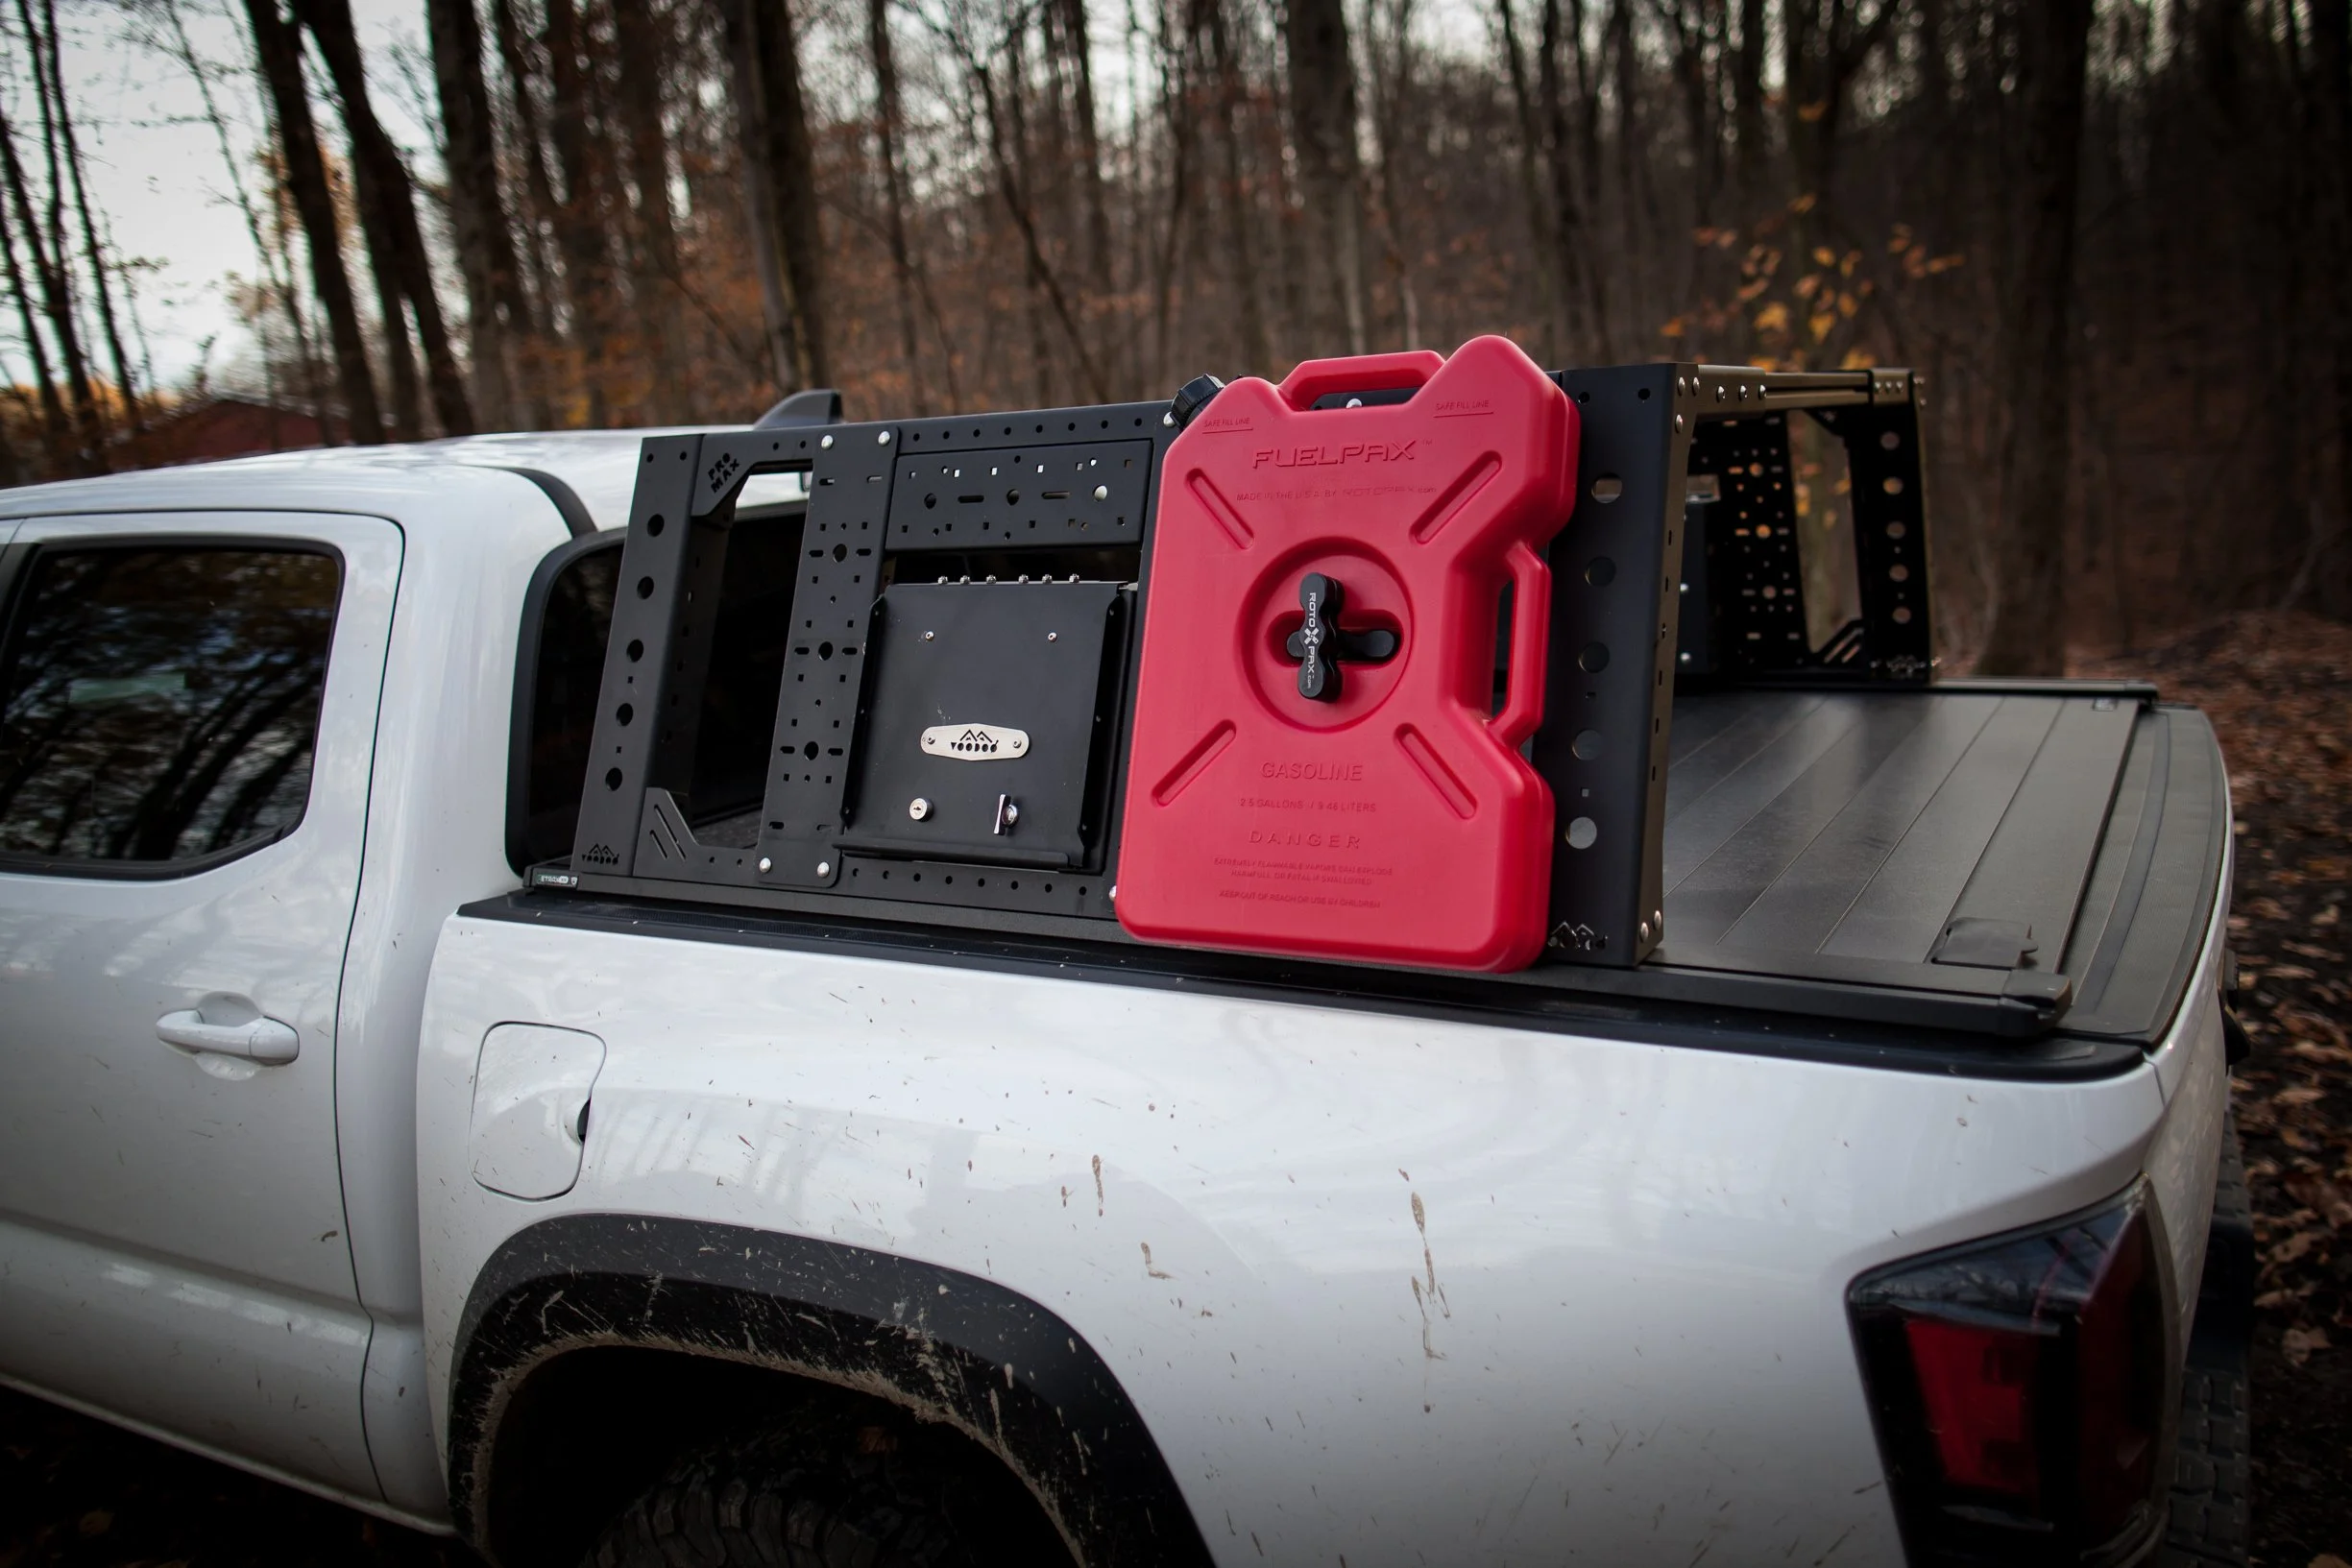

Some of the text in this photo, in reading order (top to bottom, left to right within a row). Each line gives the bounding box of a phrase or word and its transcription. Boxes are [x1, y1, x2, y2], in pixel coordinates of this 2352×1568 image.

[1436, 399, 1490, 411] SAFE FILL LINE
[1203, 418, 1221, 428] SAFE
[1235, 417, 1250, 425] LINE
[1252, 439, 1417, 470] FUELPAX
[708, 452, 731, 481] PRO
[711, 458, 740, 494] MAX
[1236, 491, 1262, 501] MADE
[1275, 490, 1294, 500] THE
[1323, 488, 1337, 498] BY
[951, 740, 999, 753] VOODOO
[1261, 762, 1364, 782] GASOLINE
[1239, 797, 1255, 808] 25
[1256, 798, 1304, 809] GALLONS
[1341, 802, 1377, 813] LITERS
[1248, 830, 1361, 849] DANGER
[582, 853, 619, 865] VOODOO
